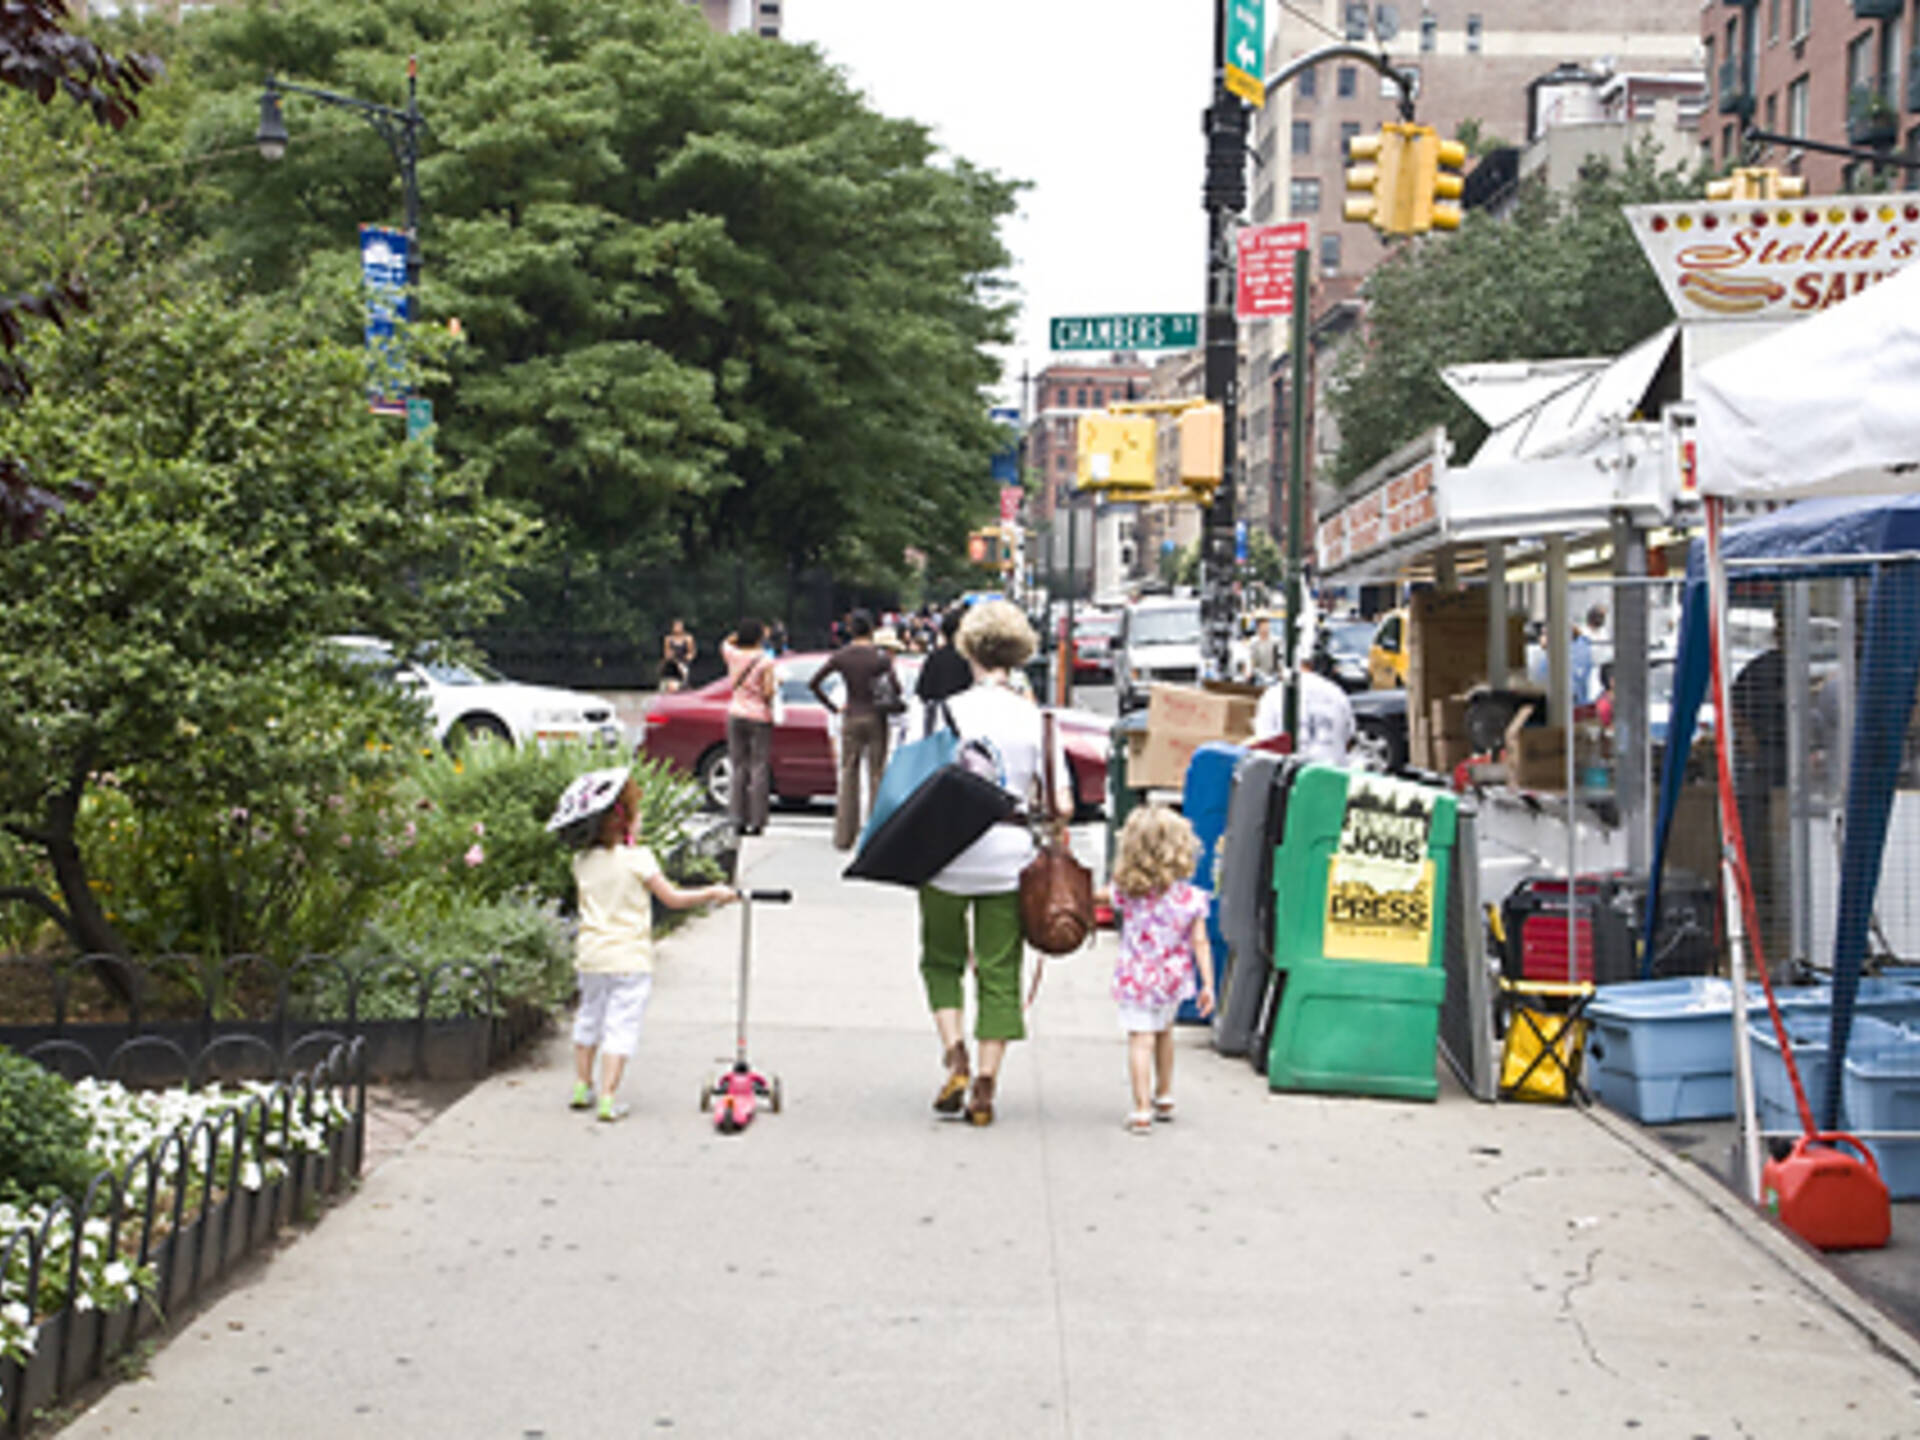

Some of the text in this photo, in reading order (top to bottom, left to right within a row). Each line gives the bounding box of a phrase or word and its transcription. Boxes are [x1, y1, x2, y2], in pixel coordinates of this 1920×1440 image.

[1677, 225, 1919, 268] Stella's
[1055, 316, 1165, 348] CHAMBERS
[1343, 827, 1421, 864] JOBS
[1331, 894, 1429, 931] PRESS
